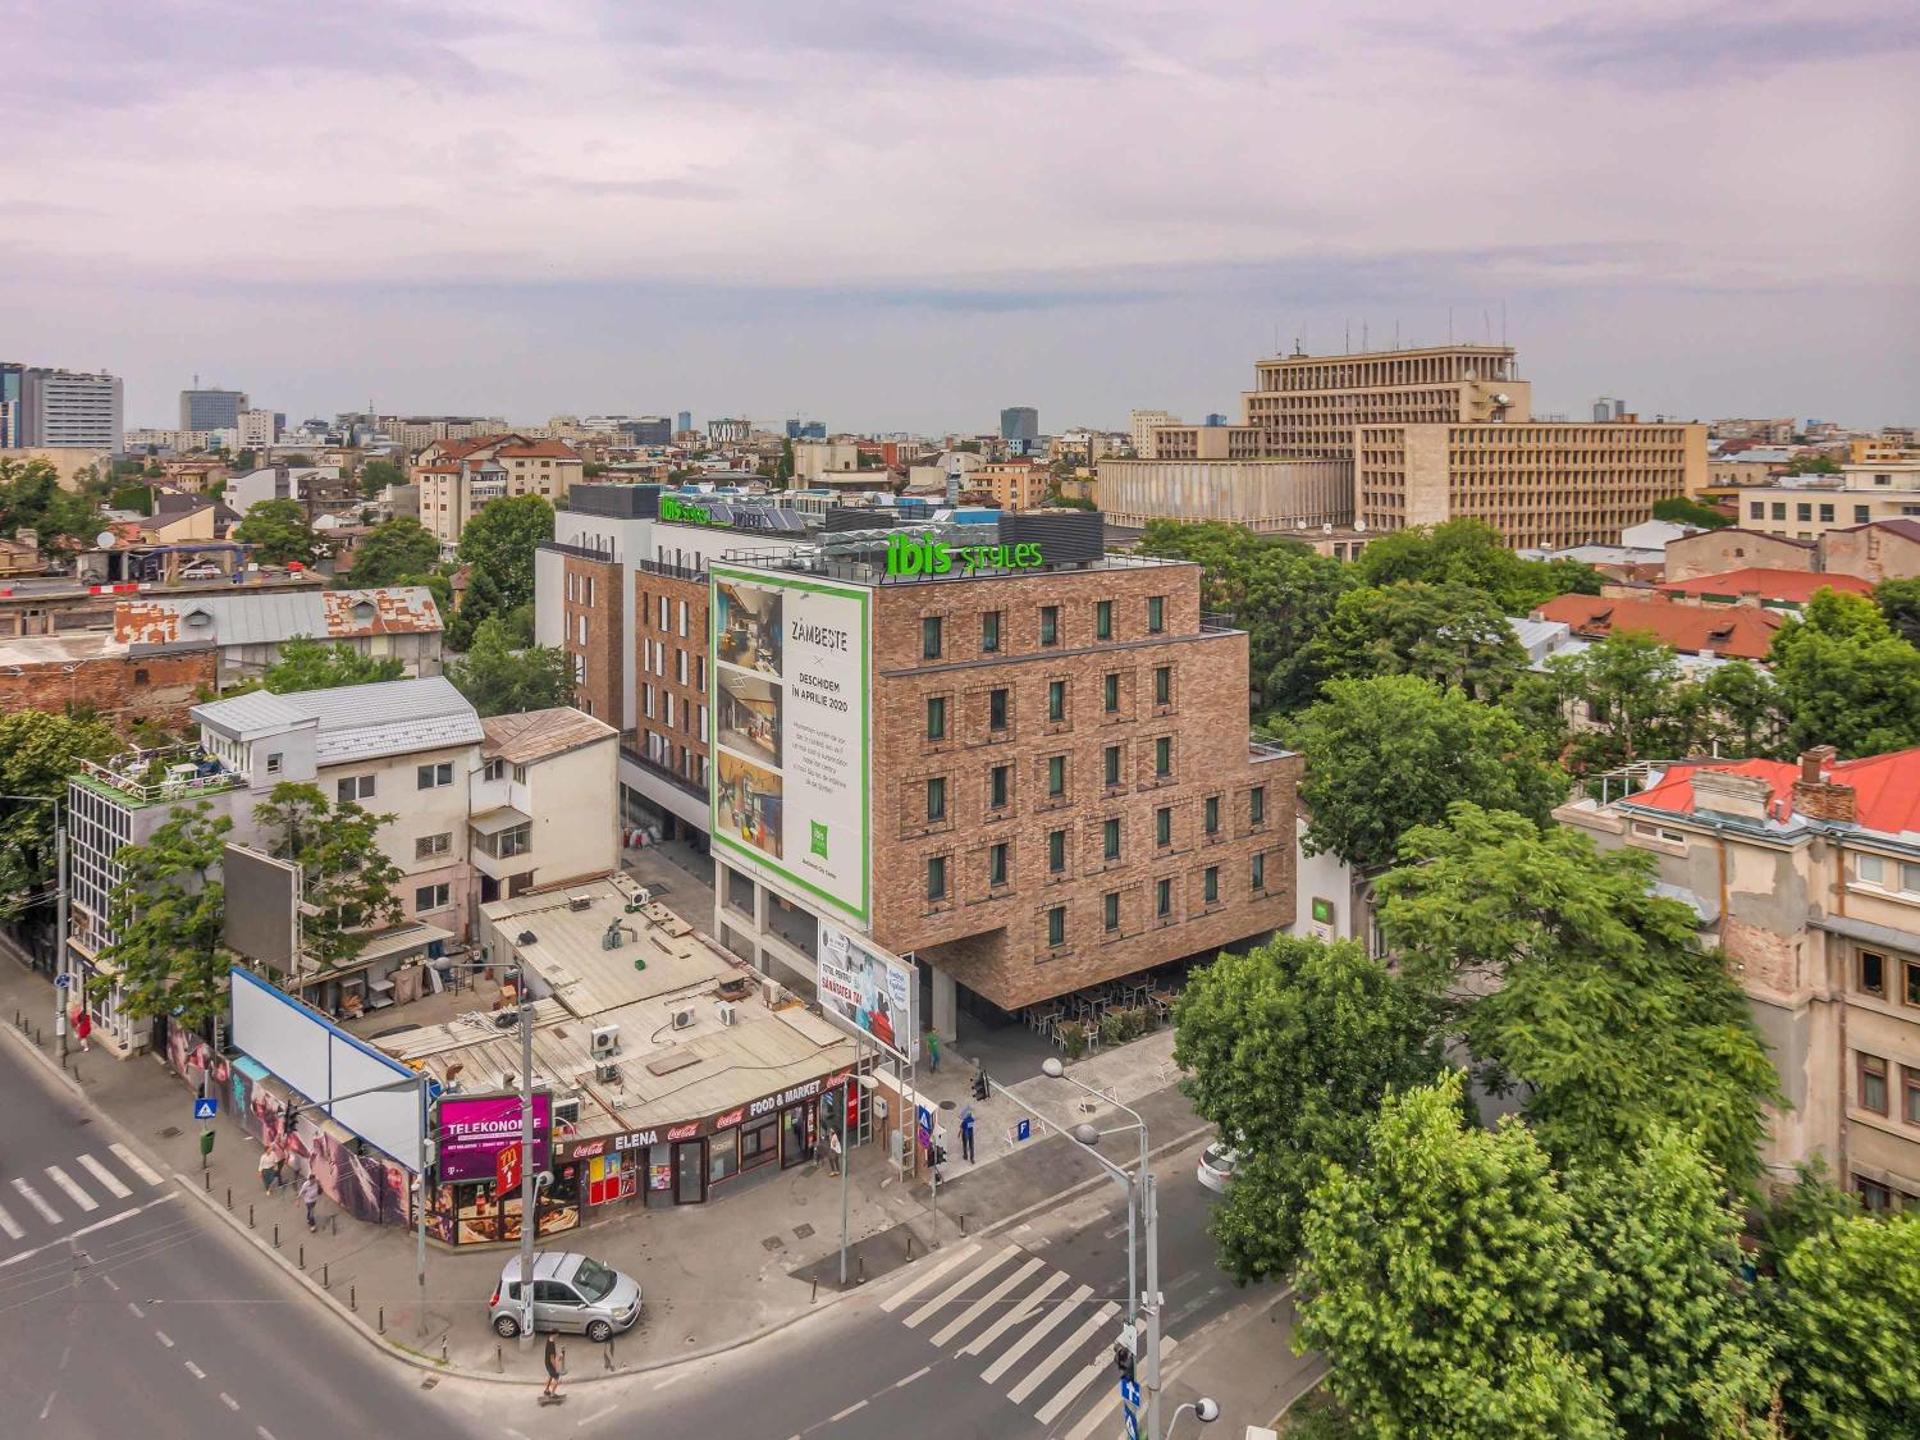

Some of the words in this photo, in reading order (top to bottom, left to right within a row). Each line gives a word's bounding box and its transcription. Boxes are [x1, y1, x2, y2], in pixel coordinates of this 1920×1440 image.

[887, 530, 951, 575] ibis
[800, 673, 840, 692] DESCHIDEM
[801, 690, 827, 706] APRILIE
[829, 698, 848, 712] 2020
[750, 1095, 776, 1116] FOOD
[777, 1093, 784, 1107] &
[785, 1080, 821, 1103] MARKET
[448, 1118, 541, 1135] TELEKONOE
[615, 1130, 658, 1150] ELENA
